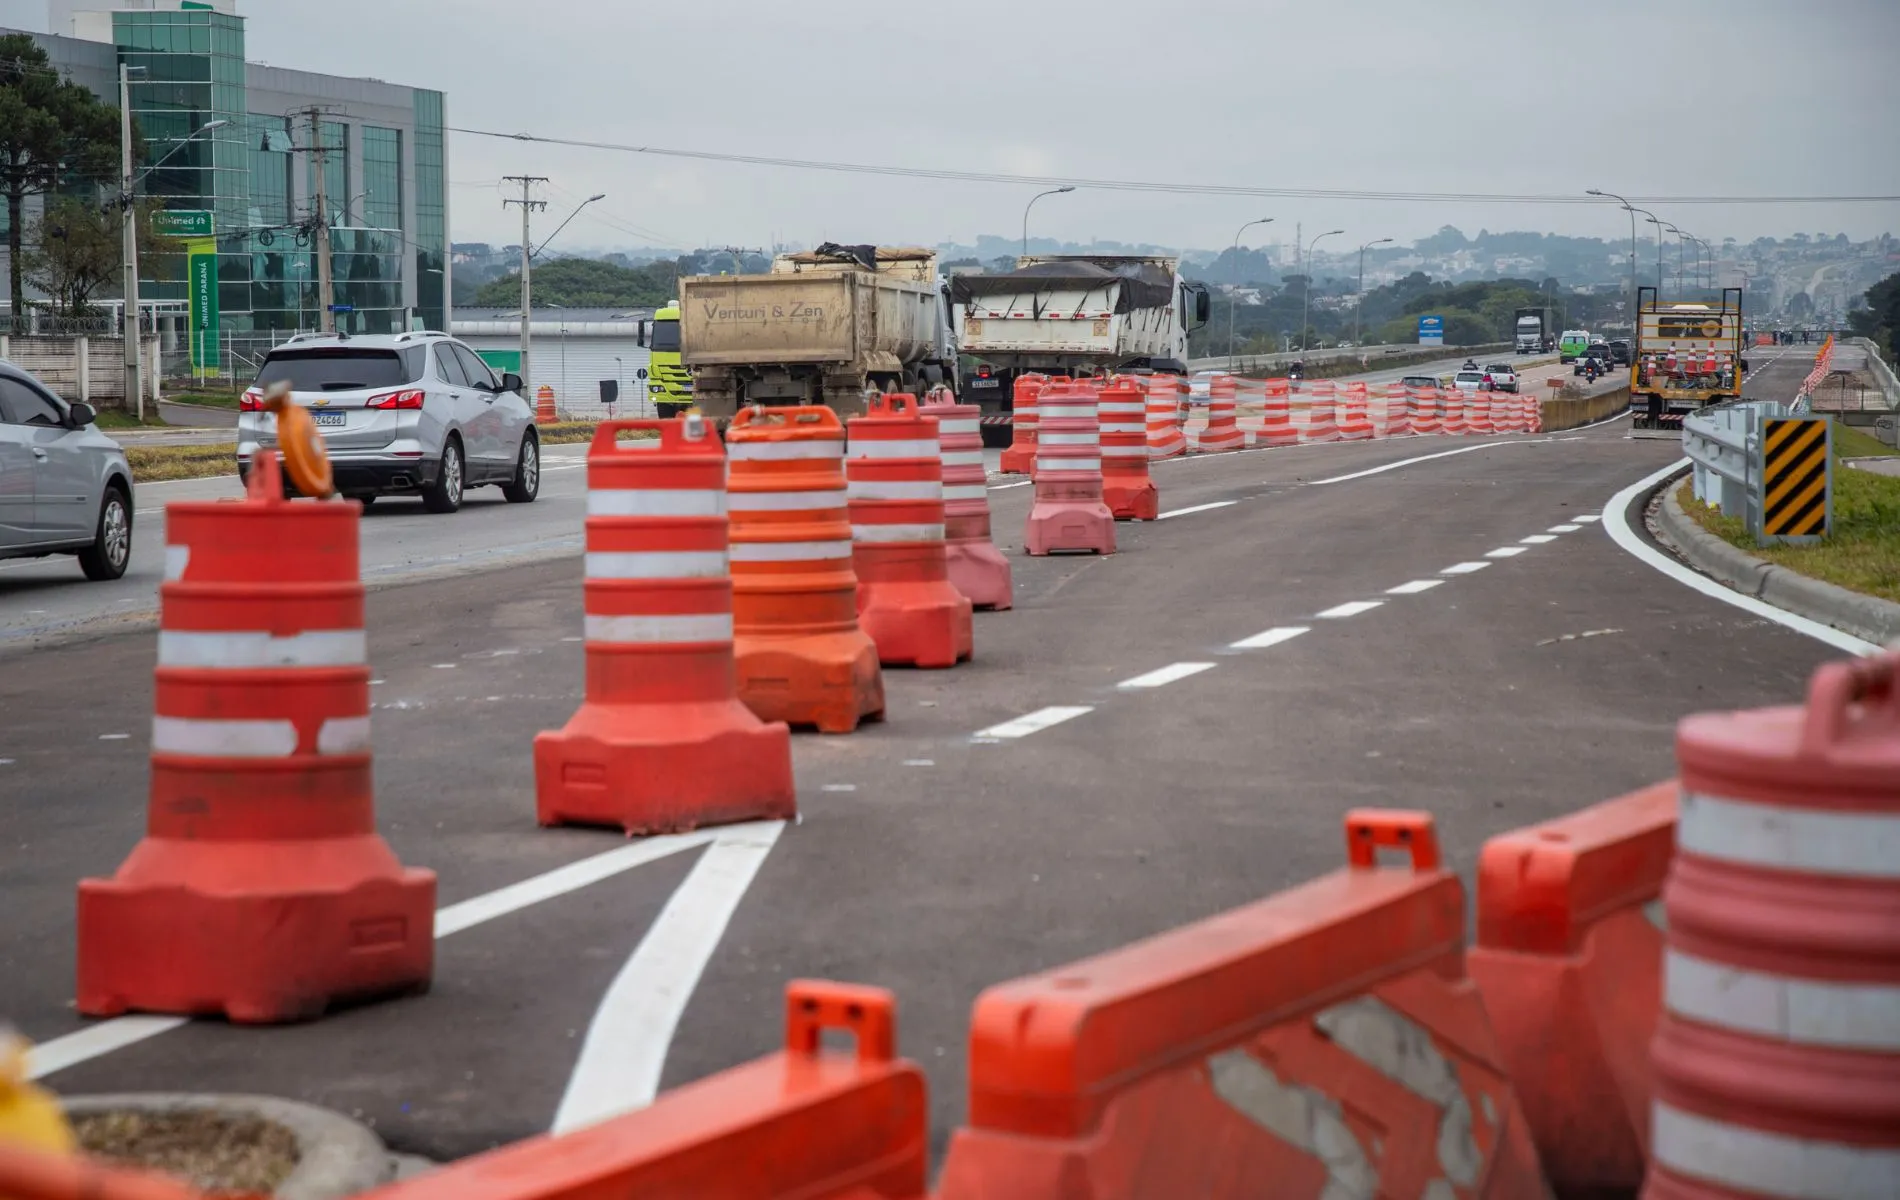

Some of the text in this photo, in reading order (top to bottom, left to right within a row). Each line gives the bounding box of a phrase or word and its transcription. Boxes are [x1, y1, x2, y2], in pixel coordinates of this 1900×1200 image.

[198, 262, 209, 328] UNIMED PARANÁ
[703, 301, 824, 320] Venturi & Zen
